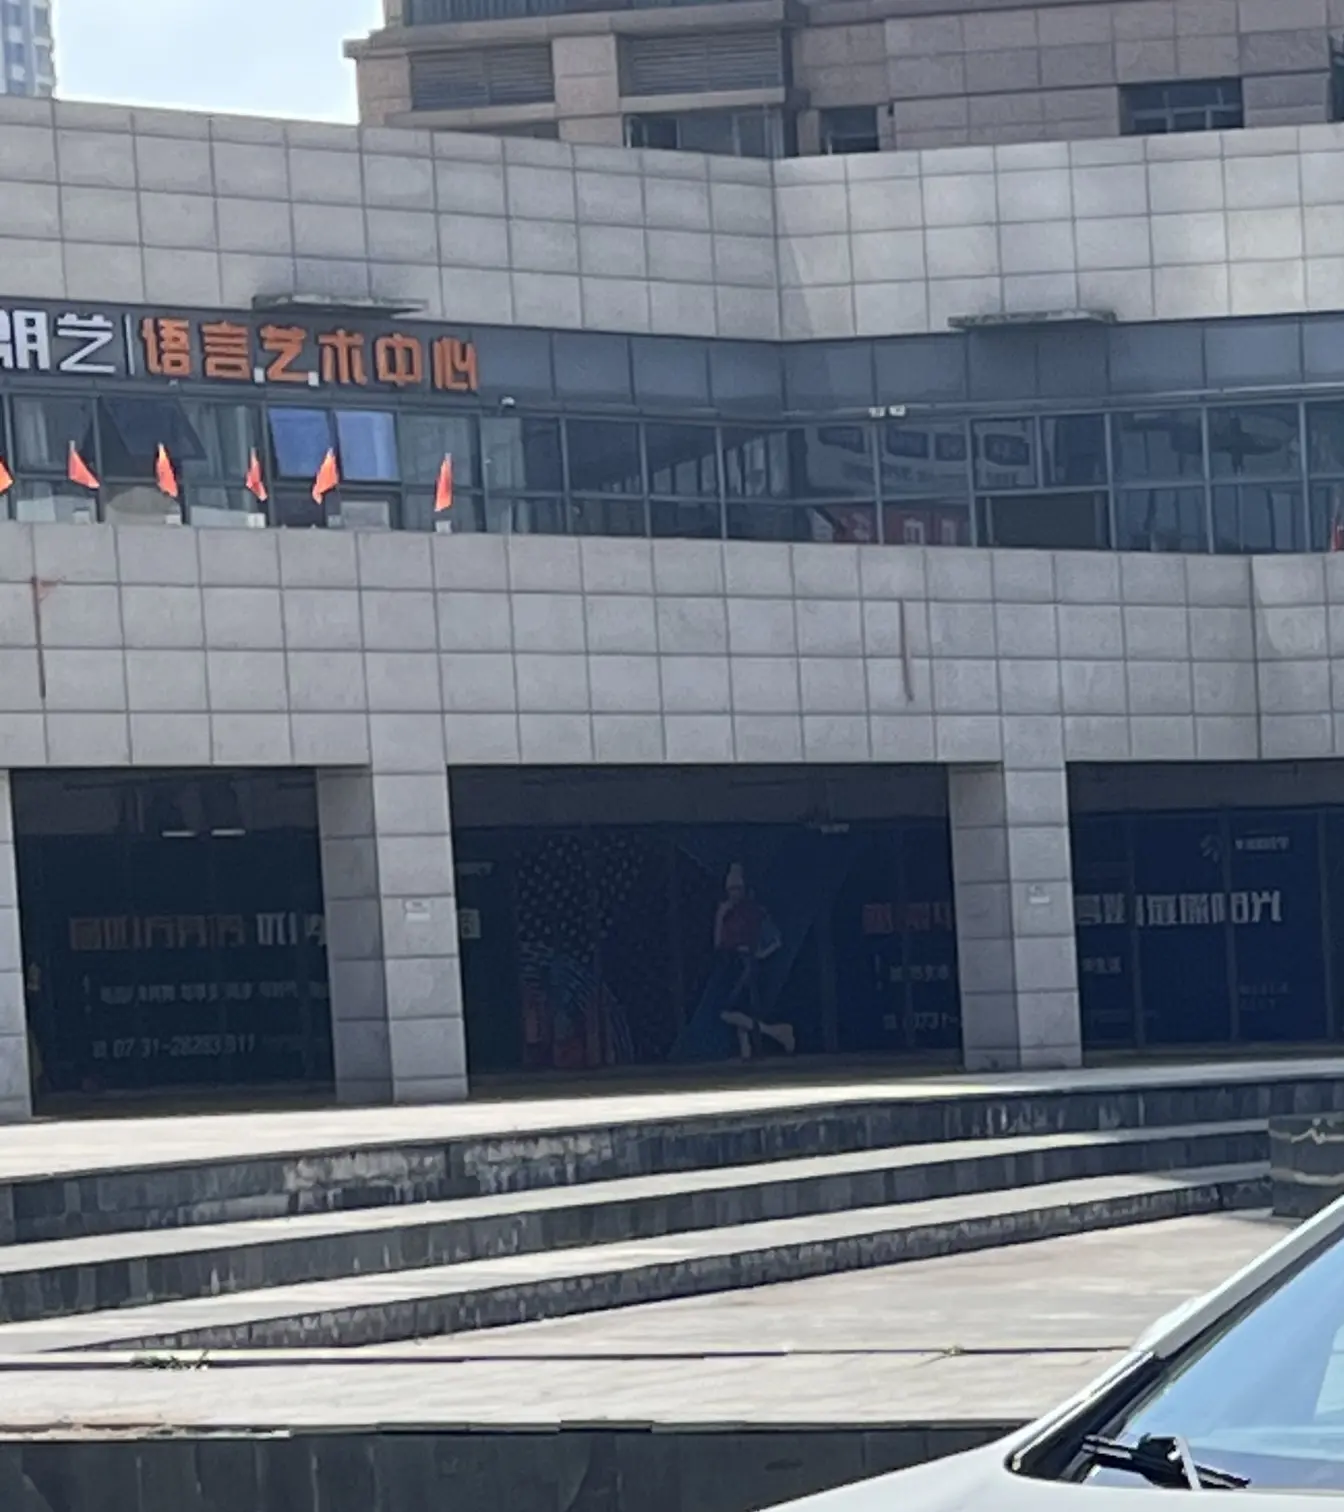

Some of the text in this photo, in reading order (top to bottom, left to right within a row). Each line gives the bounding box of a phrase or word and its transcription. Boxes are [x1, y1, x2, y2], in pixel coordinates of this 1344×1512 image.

[142, 317, 478, 391] 语言艺术中心
